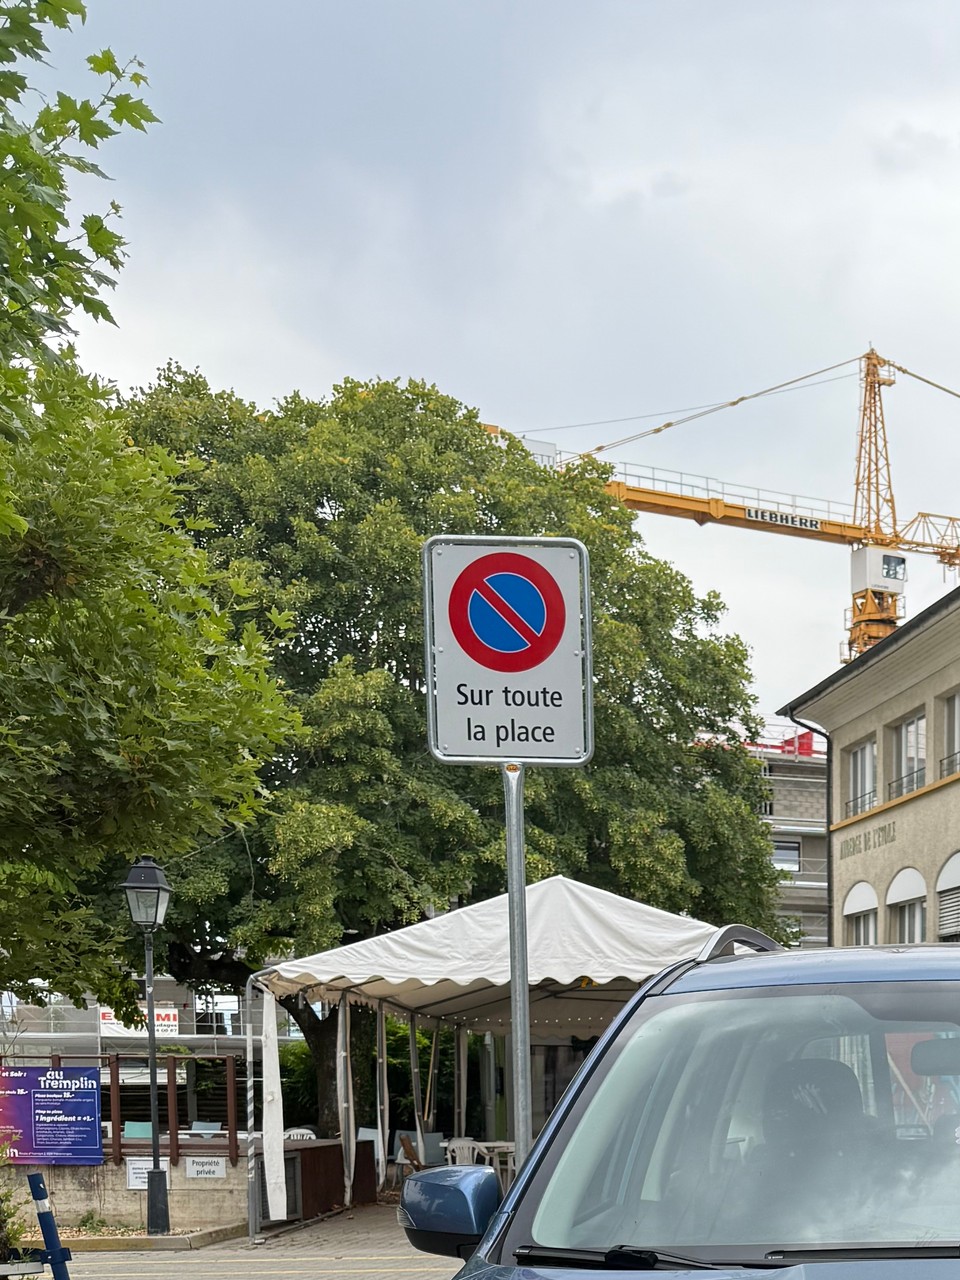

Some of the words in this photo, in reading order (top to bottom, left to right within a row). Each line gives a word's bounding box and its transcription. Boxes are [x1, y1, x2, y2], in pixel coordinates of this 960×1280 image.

[747, 508, 820, 530] LIEBHERR
[456, 683, 494, 706] Sur
[502, 686, 563, 707] toute
[467, 717, 486, 741] la
[496, 718, 556, 748] place
[46, 1071, 64, 1080] au
[38, 1077, 97, 1091] Tremplin
[191, 1159, 220, 1168] Propriété
[196, 1168, 216, 1176] privée
